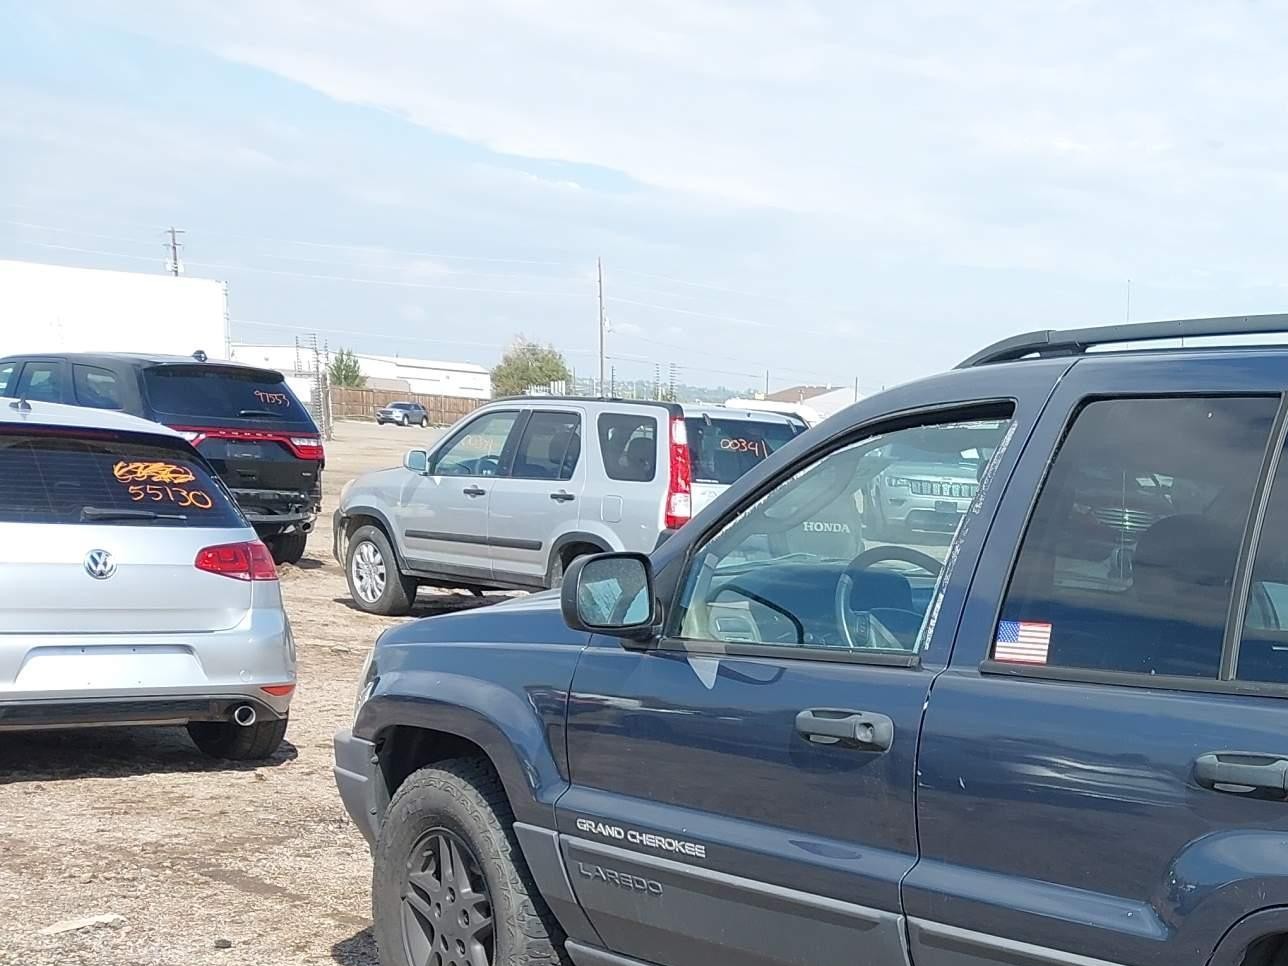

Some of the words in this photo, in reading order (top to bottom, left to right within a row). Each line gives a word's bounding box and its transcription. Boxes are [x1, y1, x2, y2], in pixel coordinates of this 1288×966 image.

[720, 438, 769, 459] 00341
[128, 485, 212, 509] 55130
[802, 521, 850, 534] HONDA
[576, 818, 624, 839] GRAND
[627, 830, 706, 858] CHEROKEE
[578, 862, 664, 894] LAREDO
